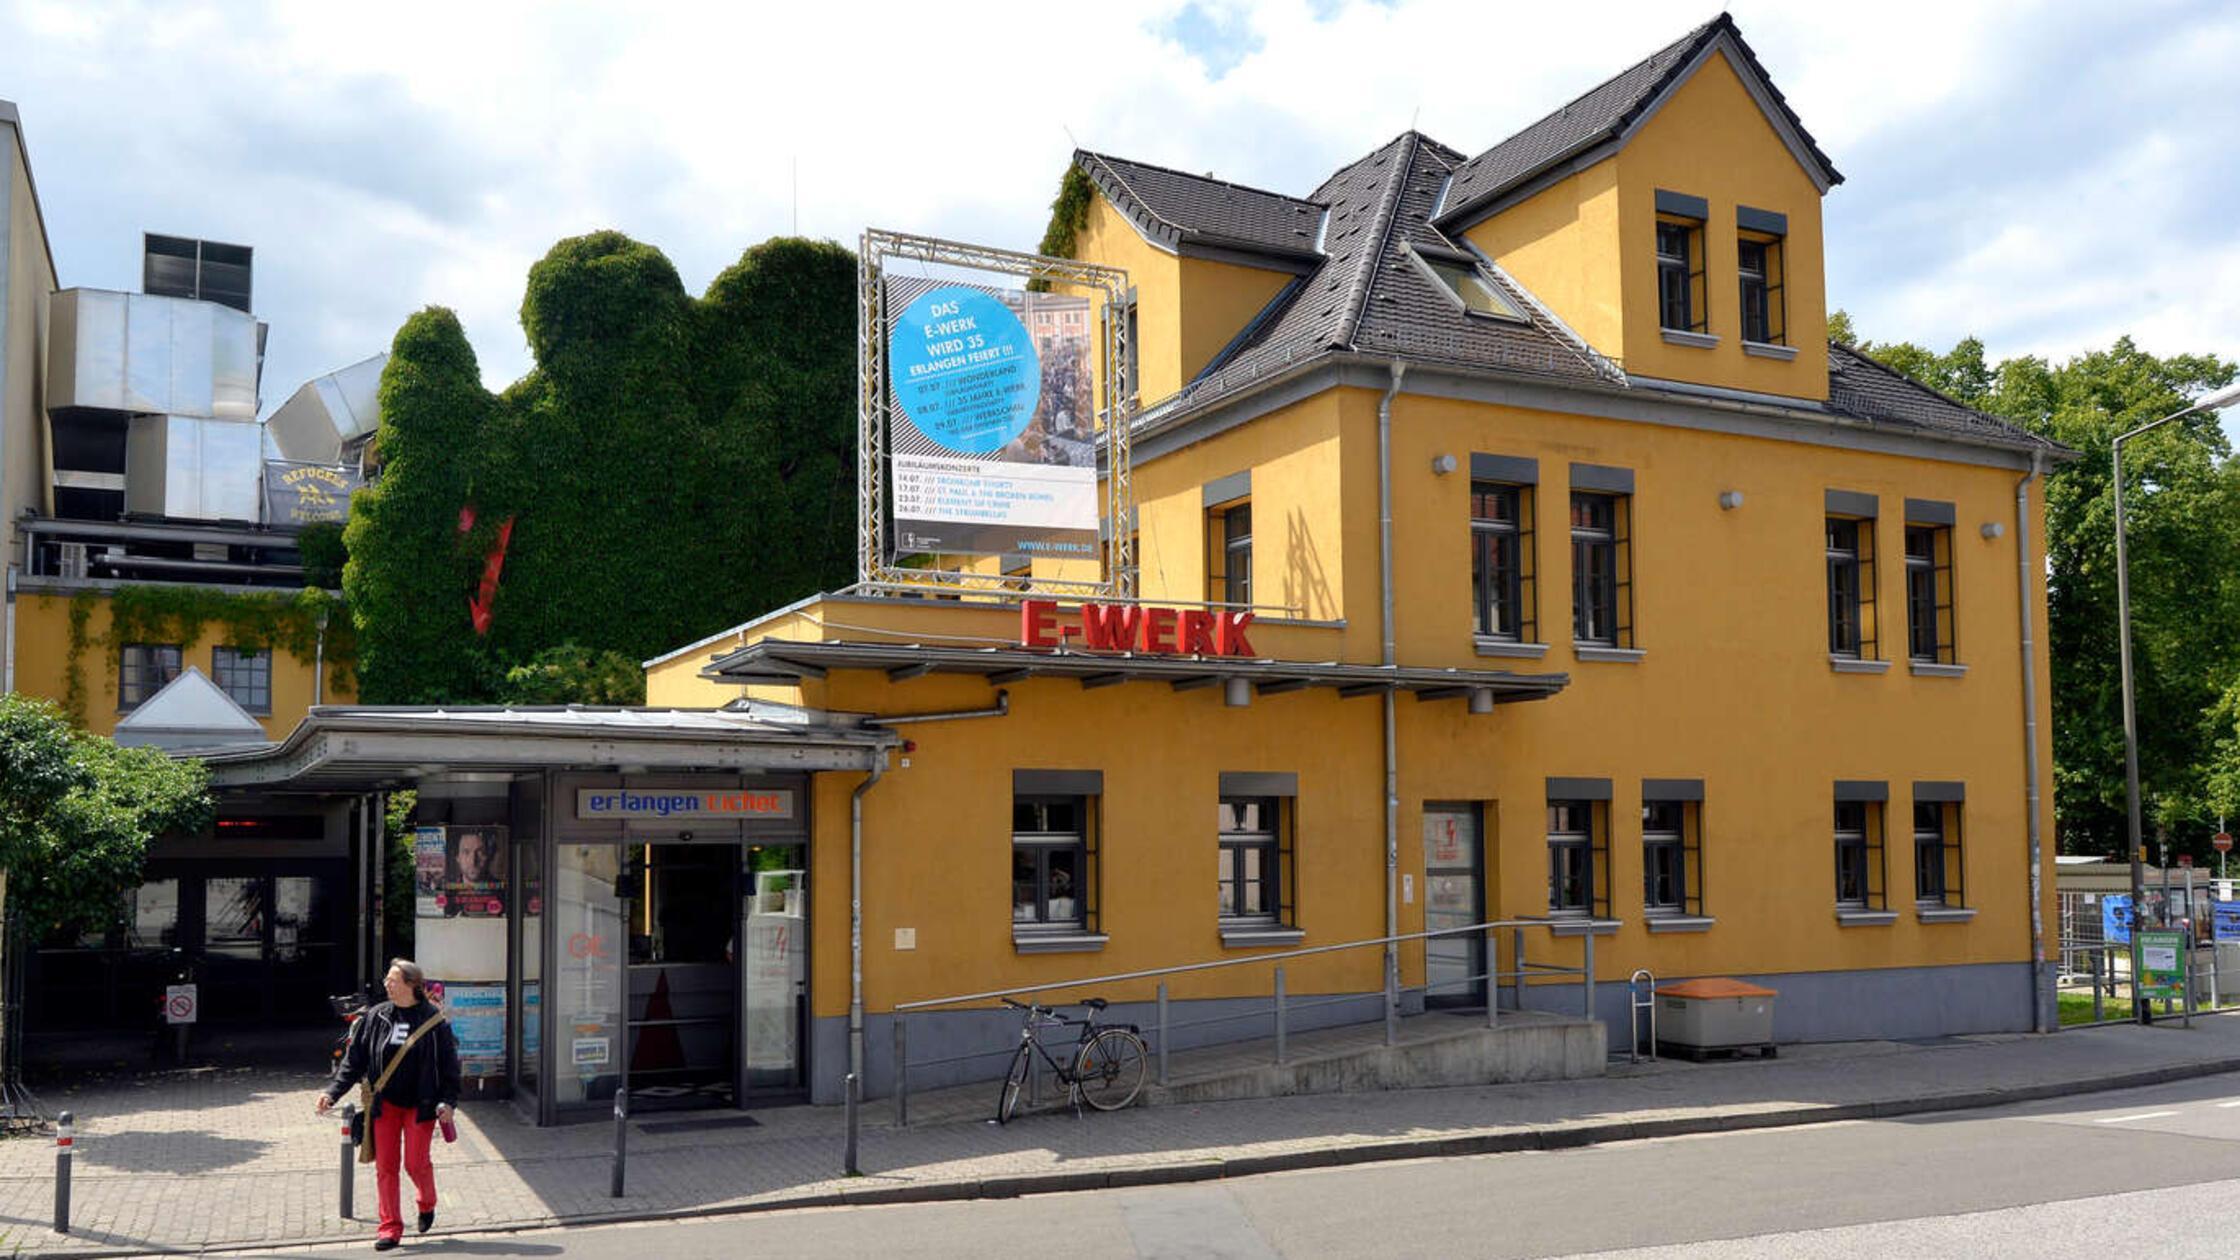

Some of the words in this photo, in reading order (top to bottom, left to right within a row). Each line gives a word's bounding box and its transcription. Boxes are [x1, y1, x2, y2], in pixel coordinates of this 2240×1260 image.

[930, 300, 960, 318] DAS
[924, 316, 976, 339] E-WERK
[926, 339, 964, 358] WIRD
[968, 334, 985, 350] 35
[910, 356, 967, 376] ERLANGEN
[968, 347, 1000, 364] FEIERT
[282, 468, 349, 488] REFUGEES
[1022, 600, 1256, 657] E-WERK
[590, 792, 699, 816] erlangen
